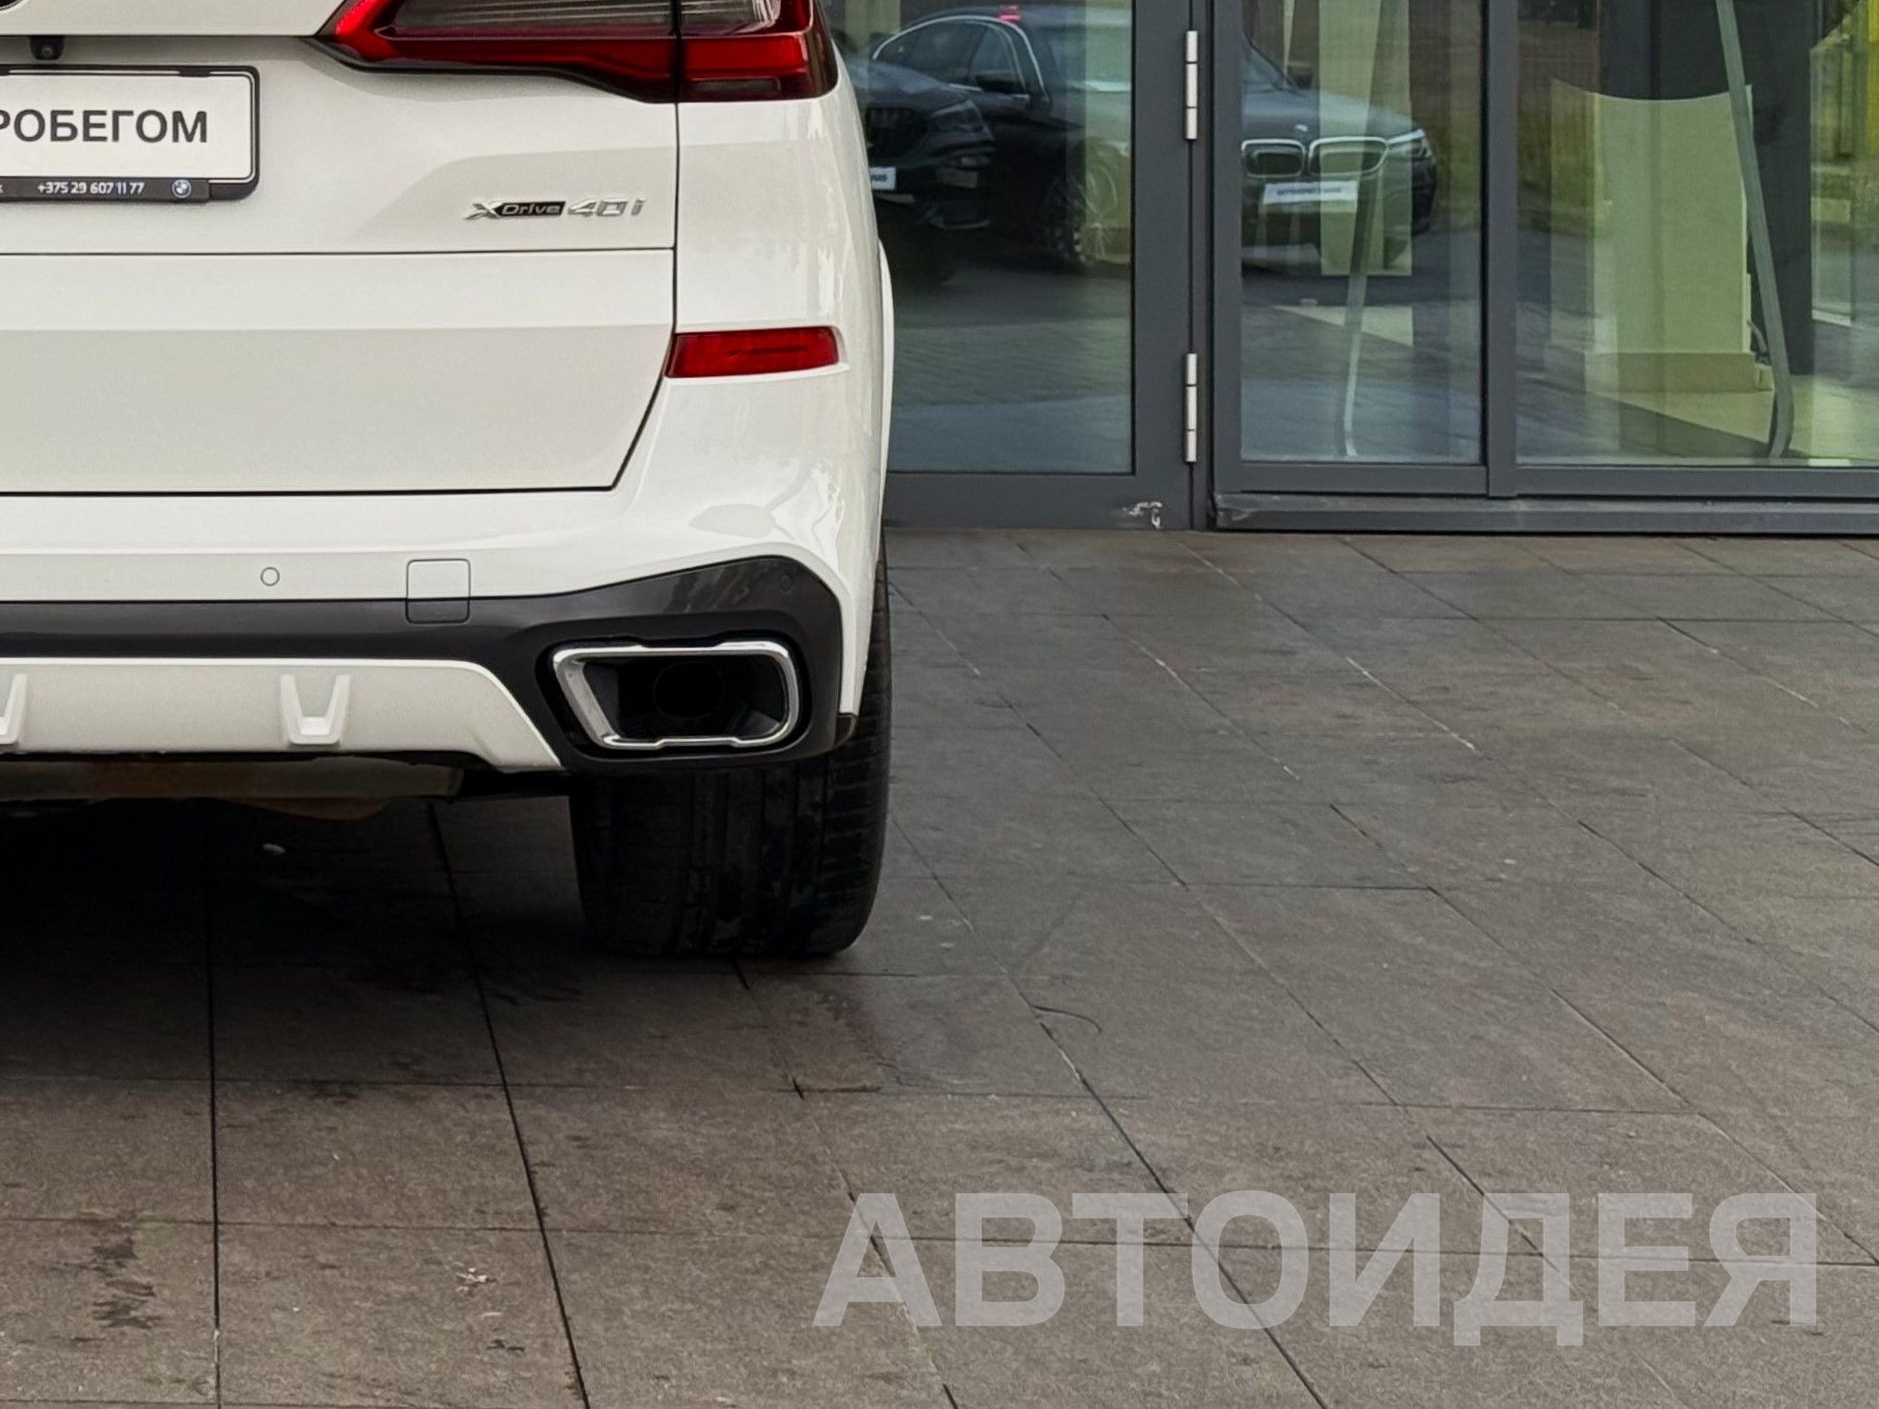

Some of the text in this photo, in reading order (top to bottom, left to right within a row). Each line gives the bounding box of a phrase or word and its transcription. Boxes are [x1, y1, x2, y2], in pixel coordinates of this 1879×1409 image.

[37, 181, 69, 195] +375
[90, 181, 114, 195] 607
[129, 182, 145, 195] 77
